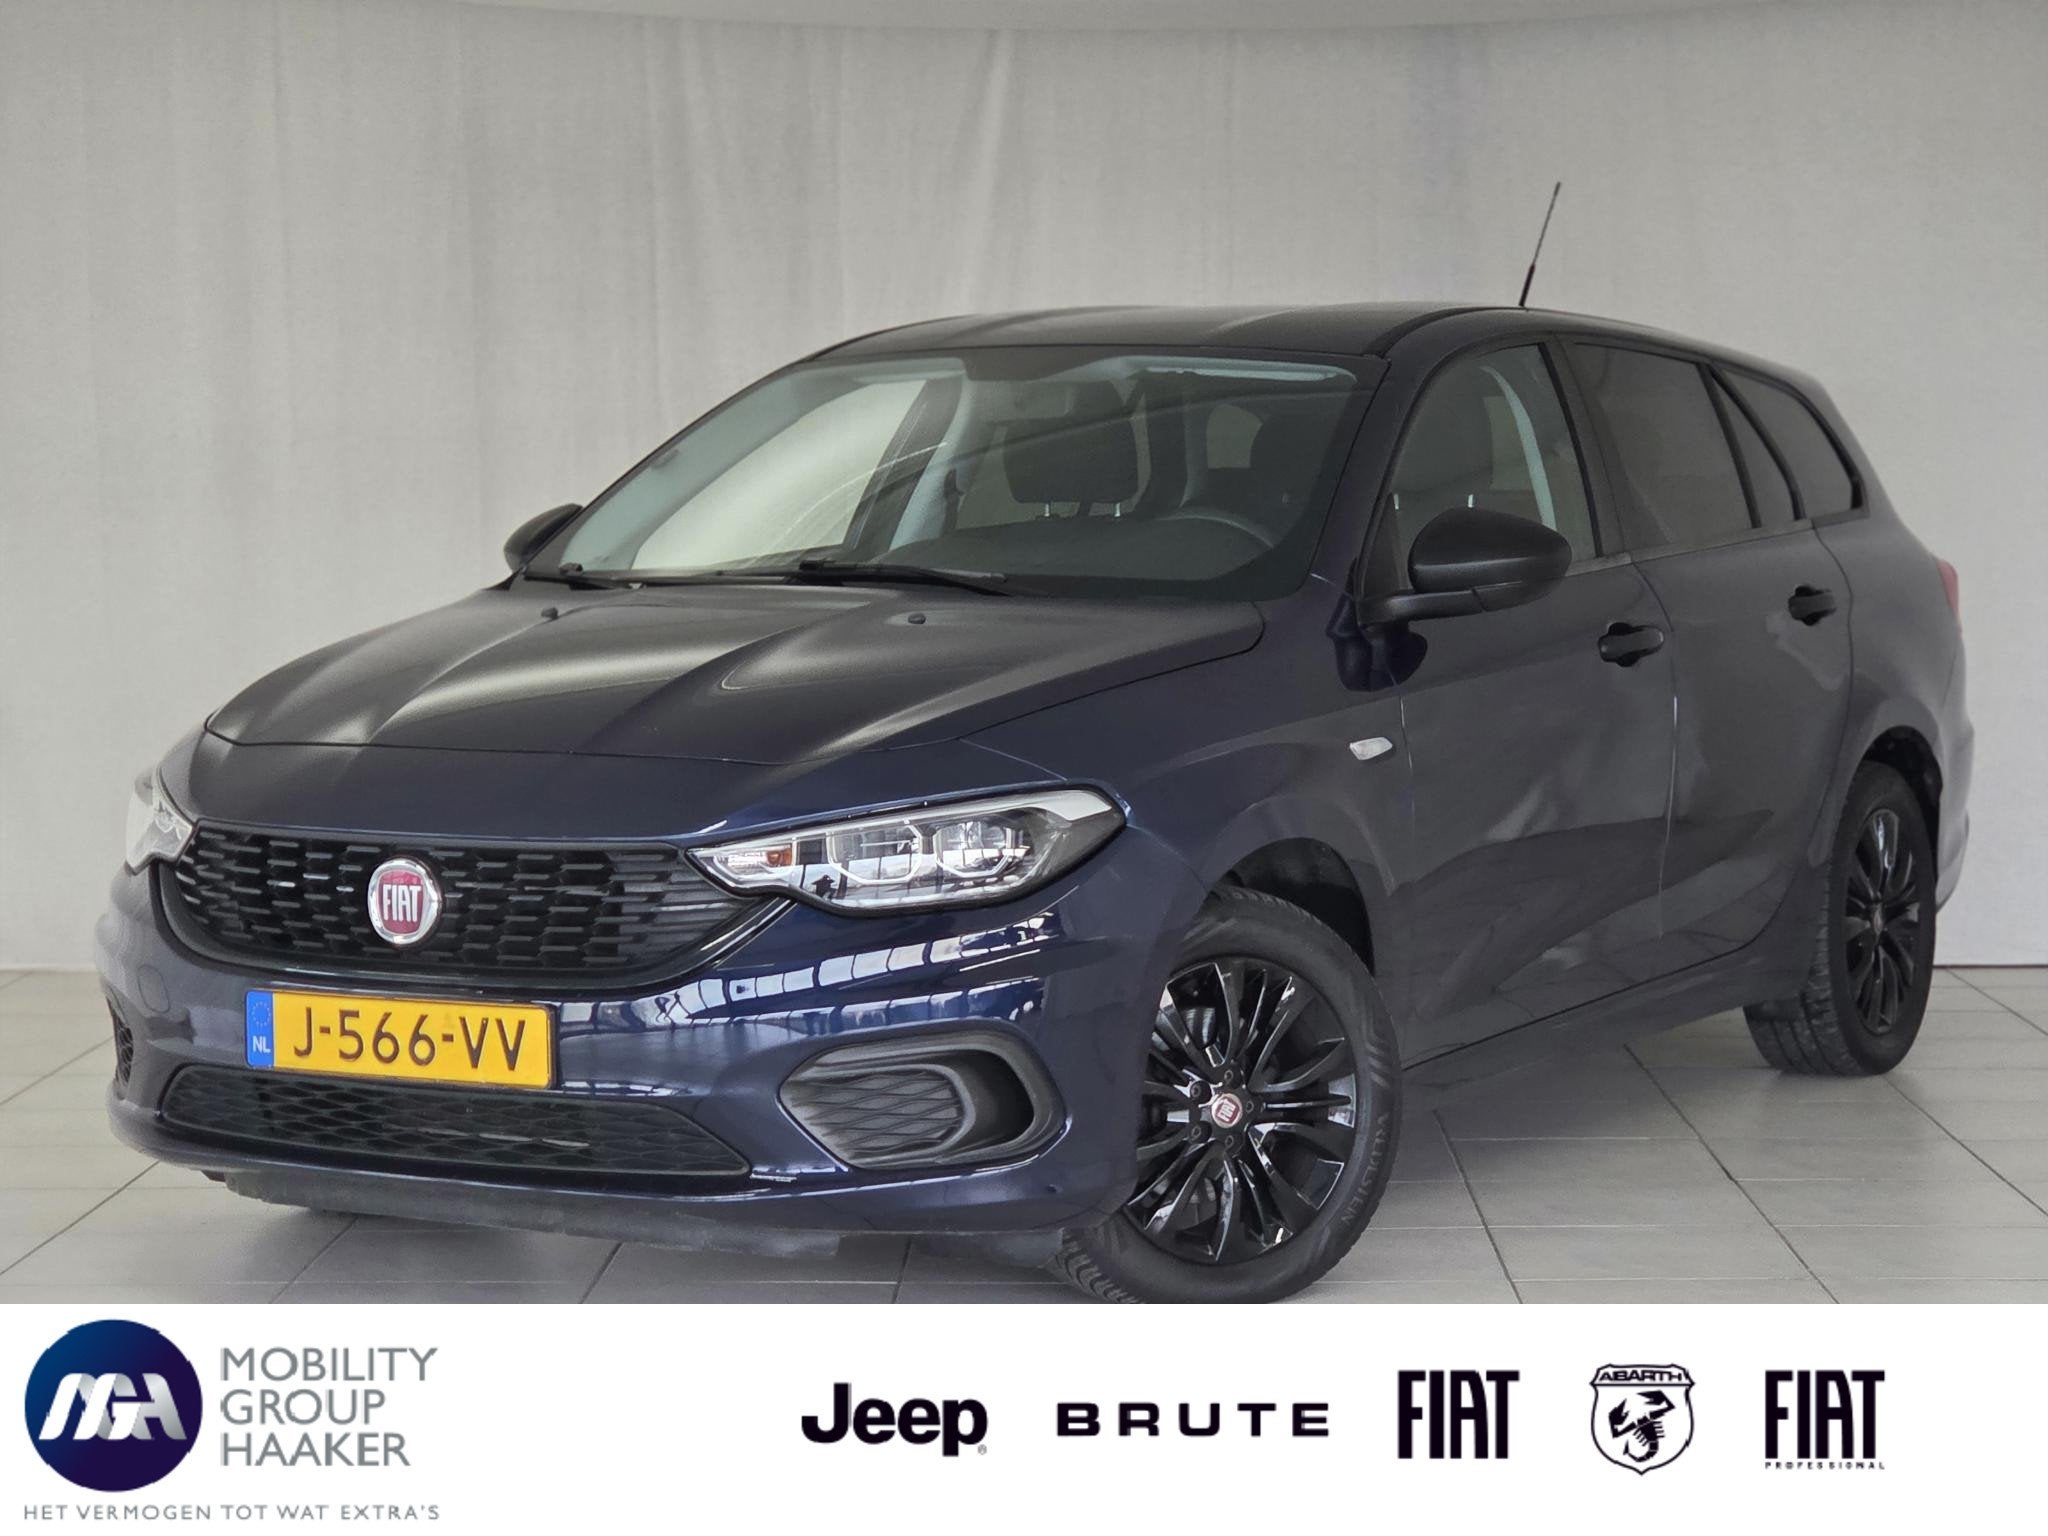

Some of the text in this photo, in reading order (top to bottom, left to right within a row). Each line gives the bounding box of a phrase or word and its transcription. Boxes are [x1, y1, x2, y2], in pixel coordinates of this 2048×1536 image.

[382, 883, 422, 923] FIAT
[252, 1035, 271, 1054] NL
[293, 1006, 526, 1072] J-566-VV
